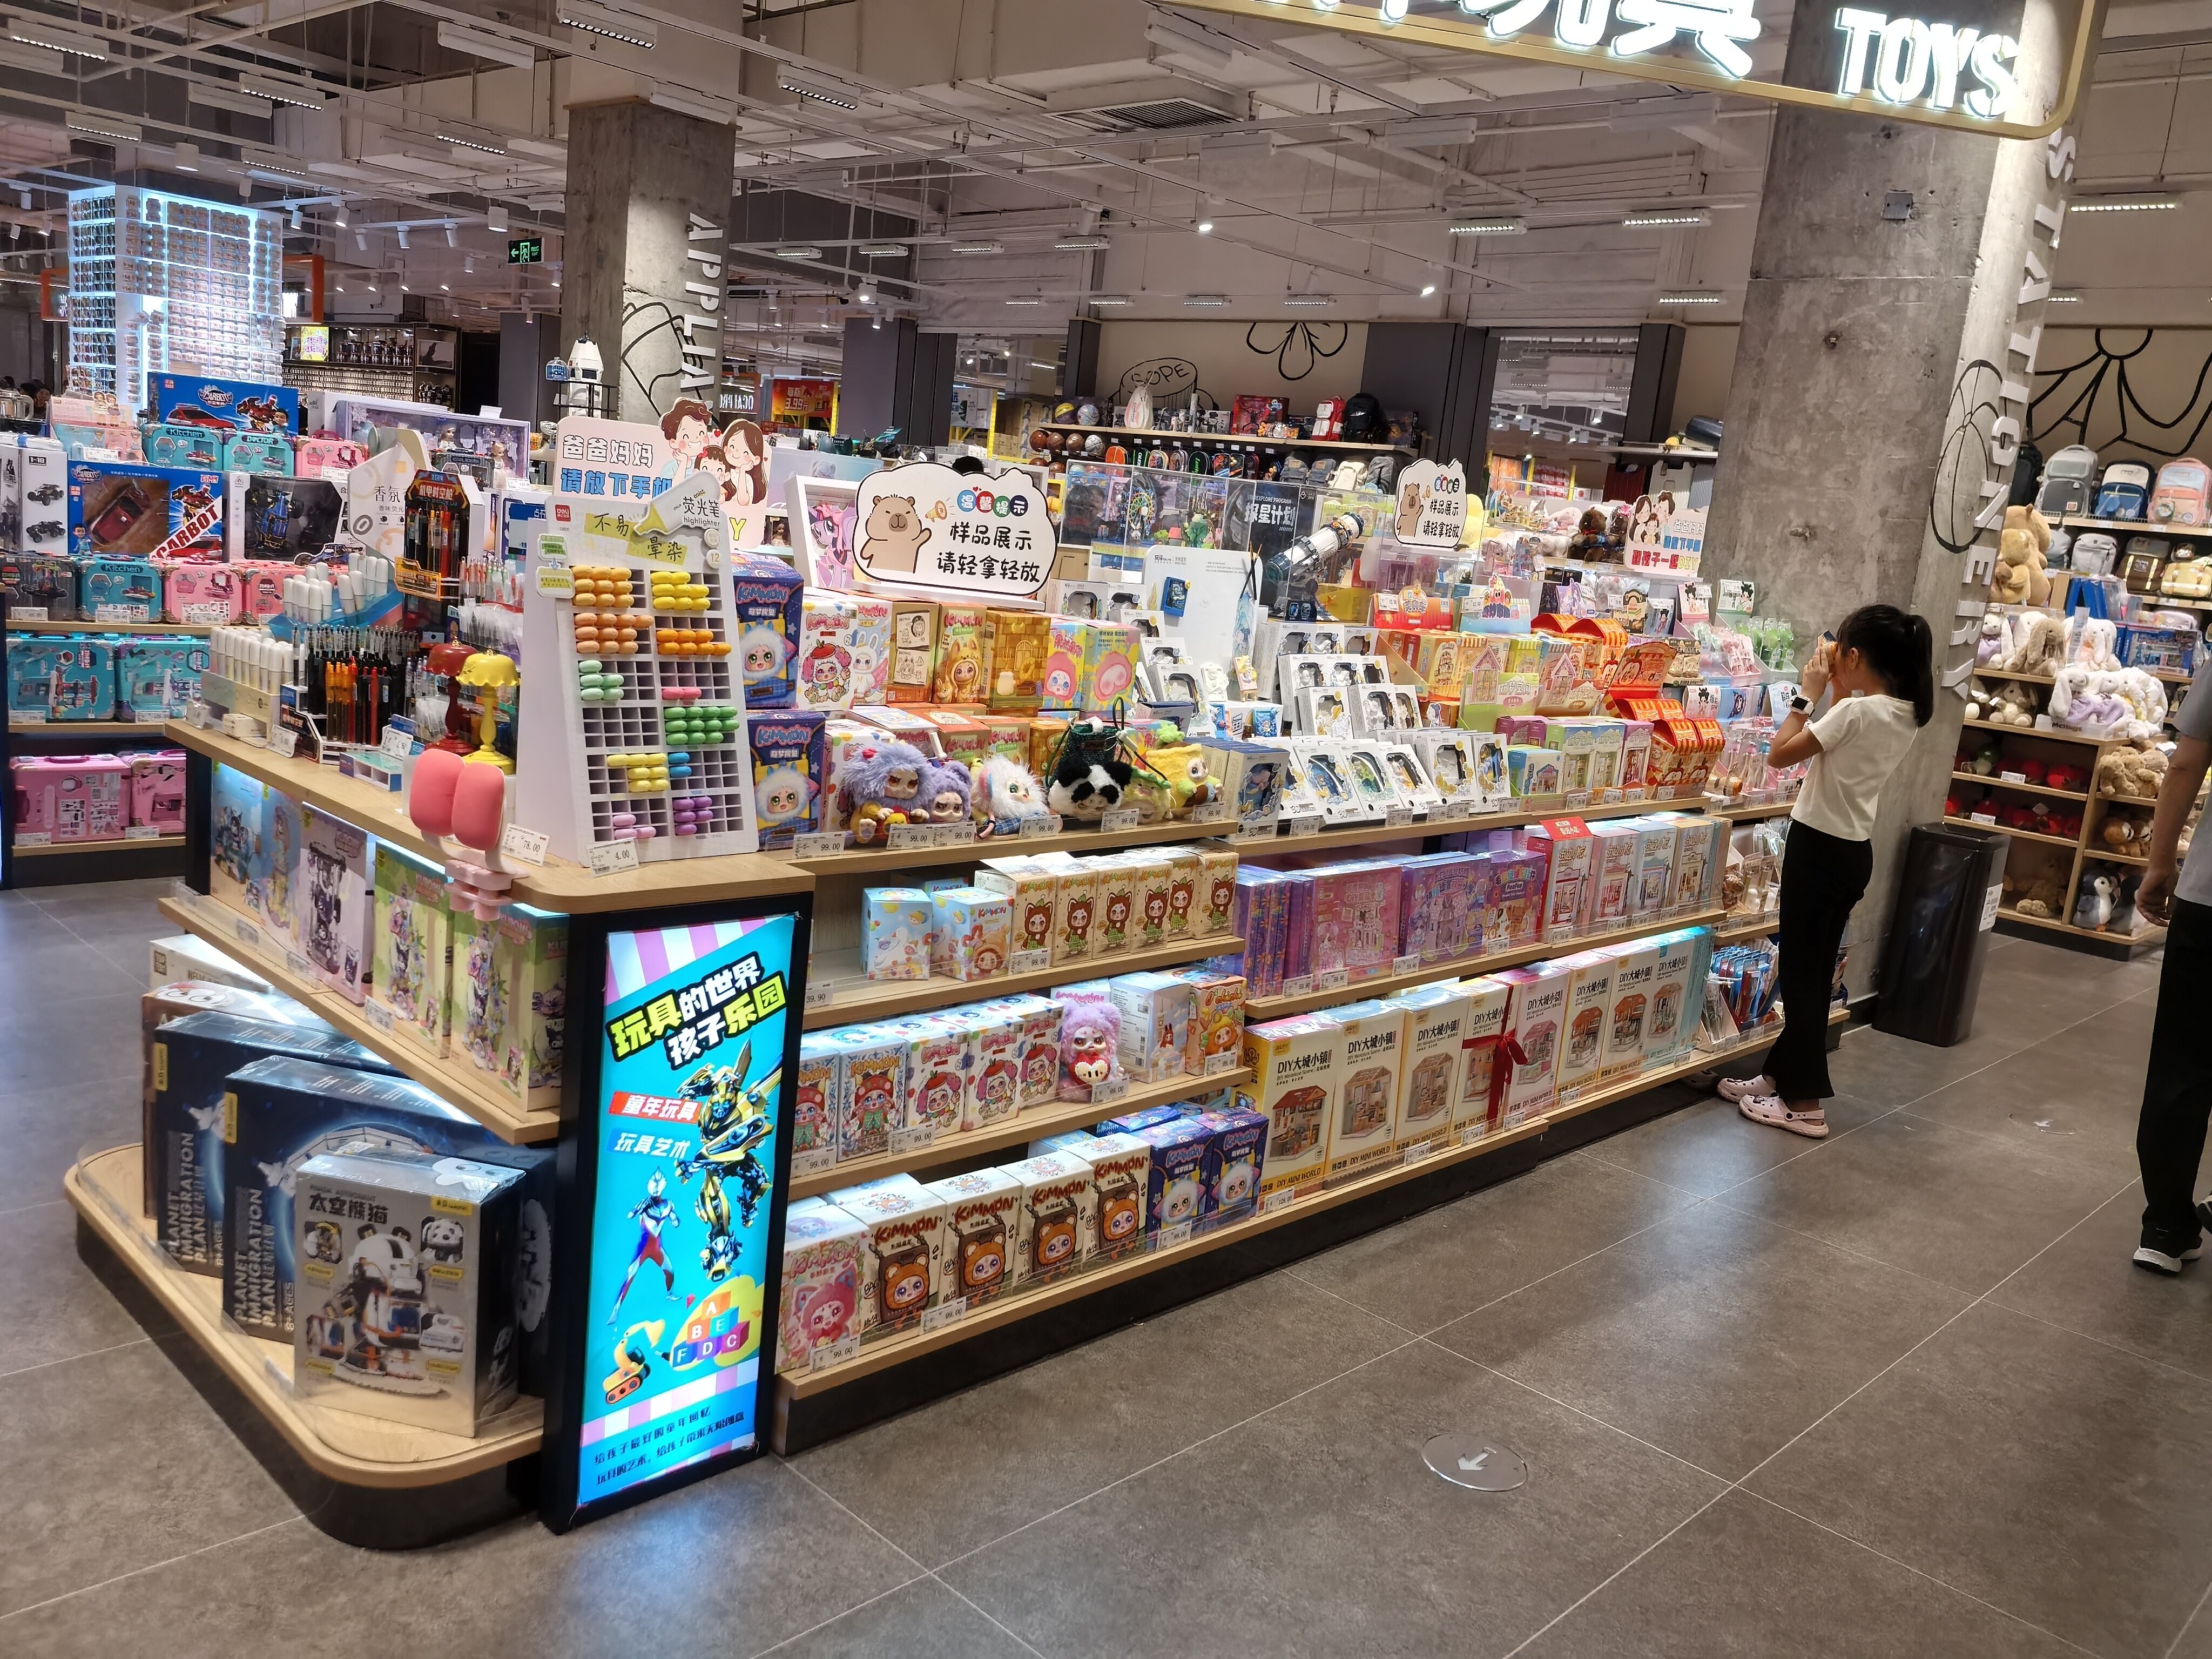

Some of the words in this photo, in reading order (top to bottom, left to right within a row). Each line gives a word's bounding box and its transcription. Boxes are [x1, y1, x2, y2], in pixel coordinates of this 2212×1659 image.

[1835, 8, 2018, 118] TOYS
[680, 212, 723, 419] APPLIA
[1943, 126, 2076, 702] STATIONERY
[563, 434, 653, 468] 爸爸妈妈
[375, 486, 407, 503] 香氛
[561, 468, 672, 500] 请放下手机
[683, 496, 720, 518] 荧光笔
[959, 492, 1026, 516] 温馨提示
[1244, 503, 1296, 526] 探星计划
[1430, 498, 1459, 516] 样品展示
[154, 503, 219, 560] CARBOT
[594, 513, 629, 537] 不易
[684, 516, 720, 528] highlighter
[1424, 521, 1459, 538] 请轻拿轻放
[949, 521, 1032, 550] 样品展示
[648, 536, 682, 562] 晕染
[937, 551, 1041, 583] 请轻拿轻放
[911, 834, 927, 842] 99.00
[955, 831, 972, 840] 99.00
[523, 839, 541, 855] 78.00
[615, 849, 630, 860] 4.00
[820, 843, 840, 851] 99.00
[1031, 957, 1047, 966] 99.00
[610, 956, 762, 1057] 玩具的世界
[1474, 1006, 1503, 1025] DIY大城小
[667, 975, 786, 1065] 孩子乐园
[1418, 1019, 1458, 1041] DIY大城小镇
[1348, 1032, 1394, 1054] DIY大城小镇
[1277, 1050, 1329, 1074] DIY大城小镇
[1109, 1085, 1125, 1094] 99.00
[622, 1095, 699, 1121] 童年玩具
[614, 1132, 691, 1159] 玩具艺术
[913, 1132, 932, 1142] 99.00
[810, 1158, 830, 1169] 99.00
[1360, 1152, 1371, 1162] MINI
[1372, 1145, 1391, 1157] WORLD
[1277, 1179, 1286, 1188] DIY
[1286, 1174, 1299, 1185] MINI
[1300, 1168, 1321, 1180] WORLD
[180, 1134, 193, 1262] IMMIGRATION
[309, 1193, 388, 1225] 太空熊猫
[1173, 1231, 1187, 1239] 99.00
[248, 1189, 262, 1323] IMMIGRATION
[235, 1249, 246, 1323] PLANET
[262, 1280, 275, 1327] PLAN
[285, 1283, 294, 1316] AGES
[706, 1301, 717, 1316] A
[945, 1307, 962, 1318] 99.00
[691, 1325, 703, 1339] B
[716, 1318, 725, 1332] E
[703, 1341, 713, 1355] D
[727, 1334, 737, 1348] C
[833, 1346, 853, 1358] 99.00
[677, 1347, 687, 1363] F
[595, 1406, 711, 1465] 给孩子最好的童年回忆
